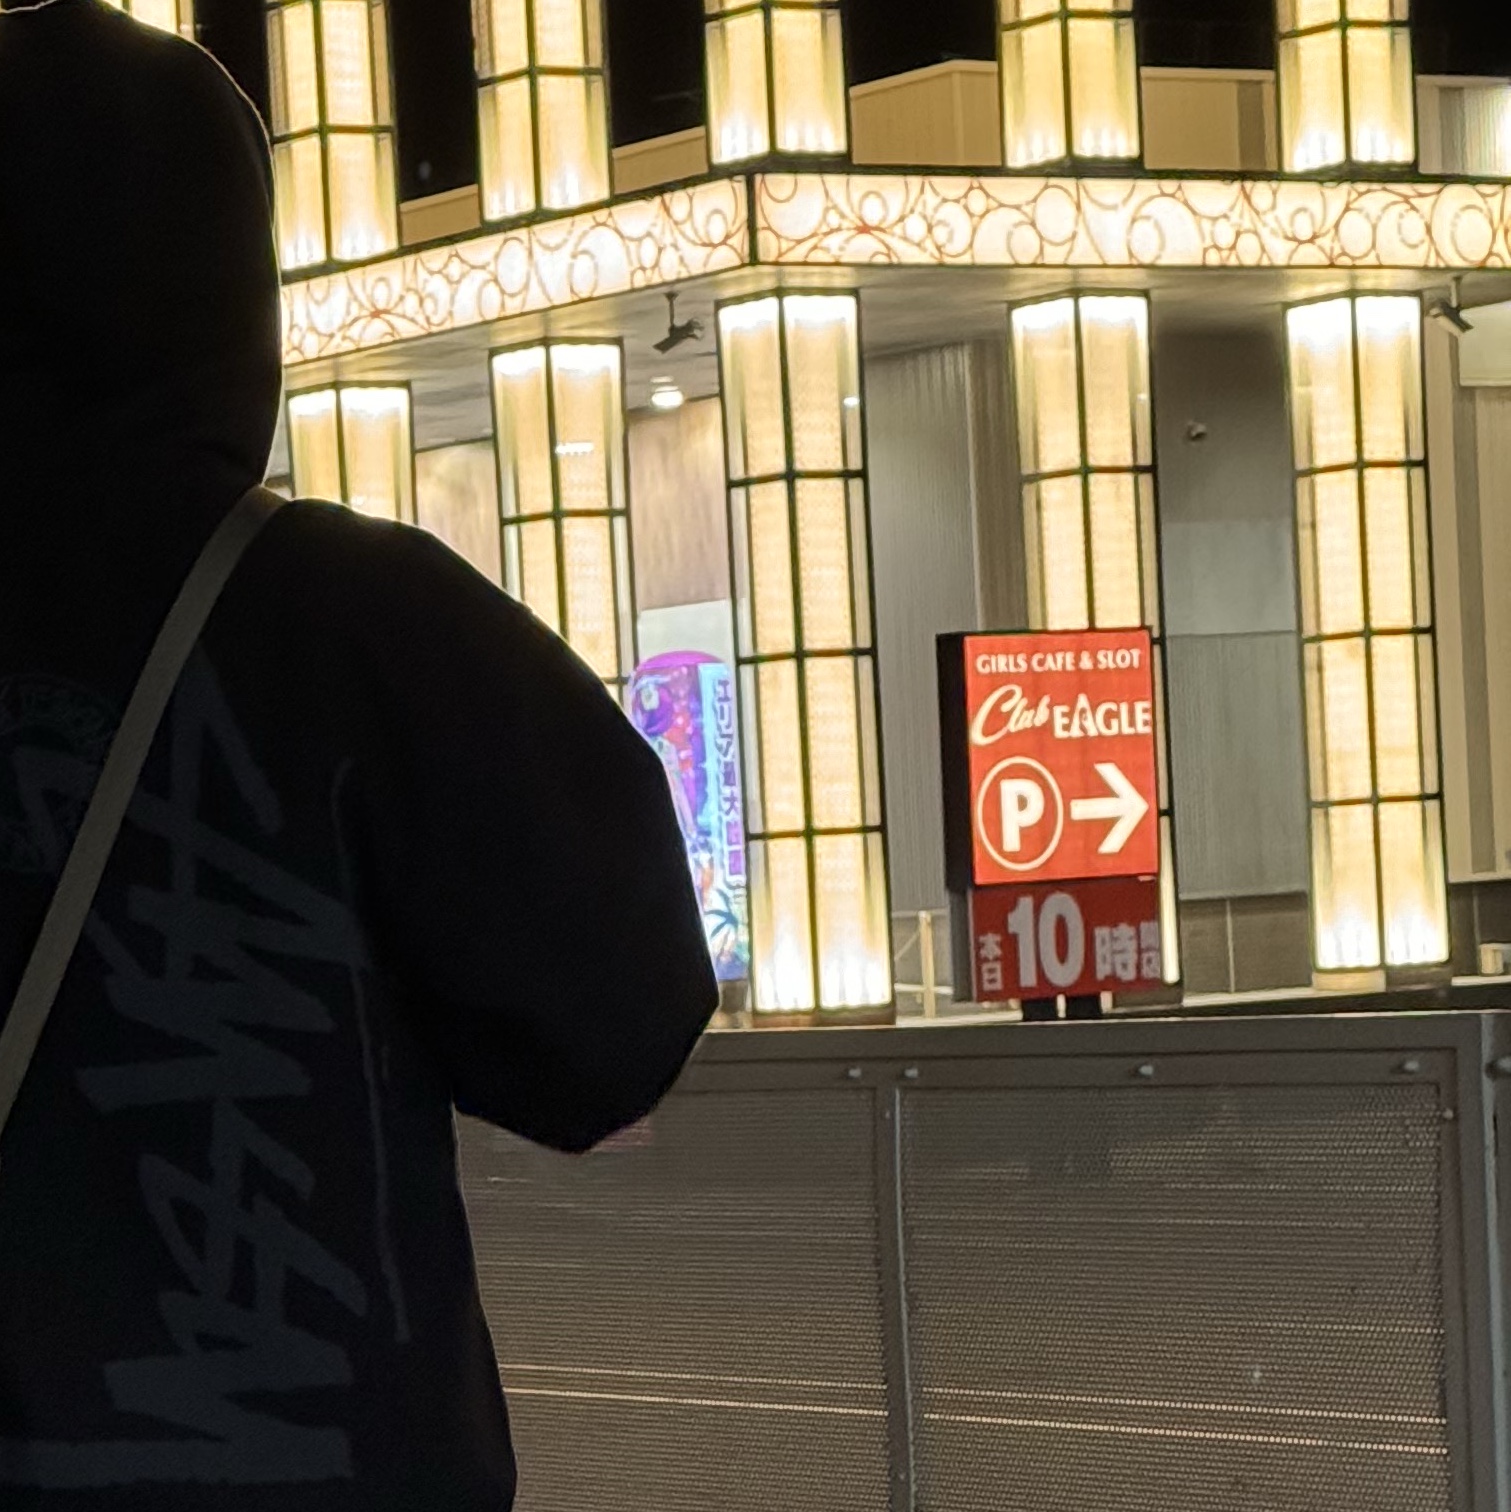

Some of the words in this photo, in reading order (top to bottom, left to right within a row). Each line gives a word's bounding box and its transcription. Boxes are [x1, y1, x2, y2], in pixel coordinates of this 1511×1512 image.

[976, 651, 1028, 674] GIRLS
[1031, 650, 1075, 671] CAFE
[1079, 650, 1094, 670] &
[1097, 648, 1141, 670] SLOT
[970, 684, 1051, 746] Club
[1053, 693, 1153, 738] EAGLE
[1000, 778, 1046, 853] P
[1007, 891, 1085, 988] 10
